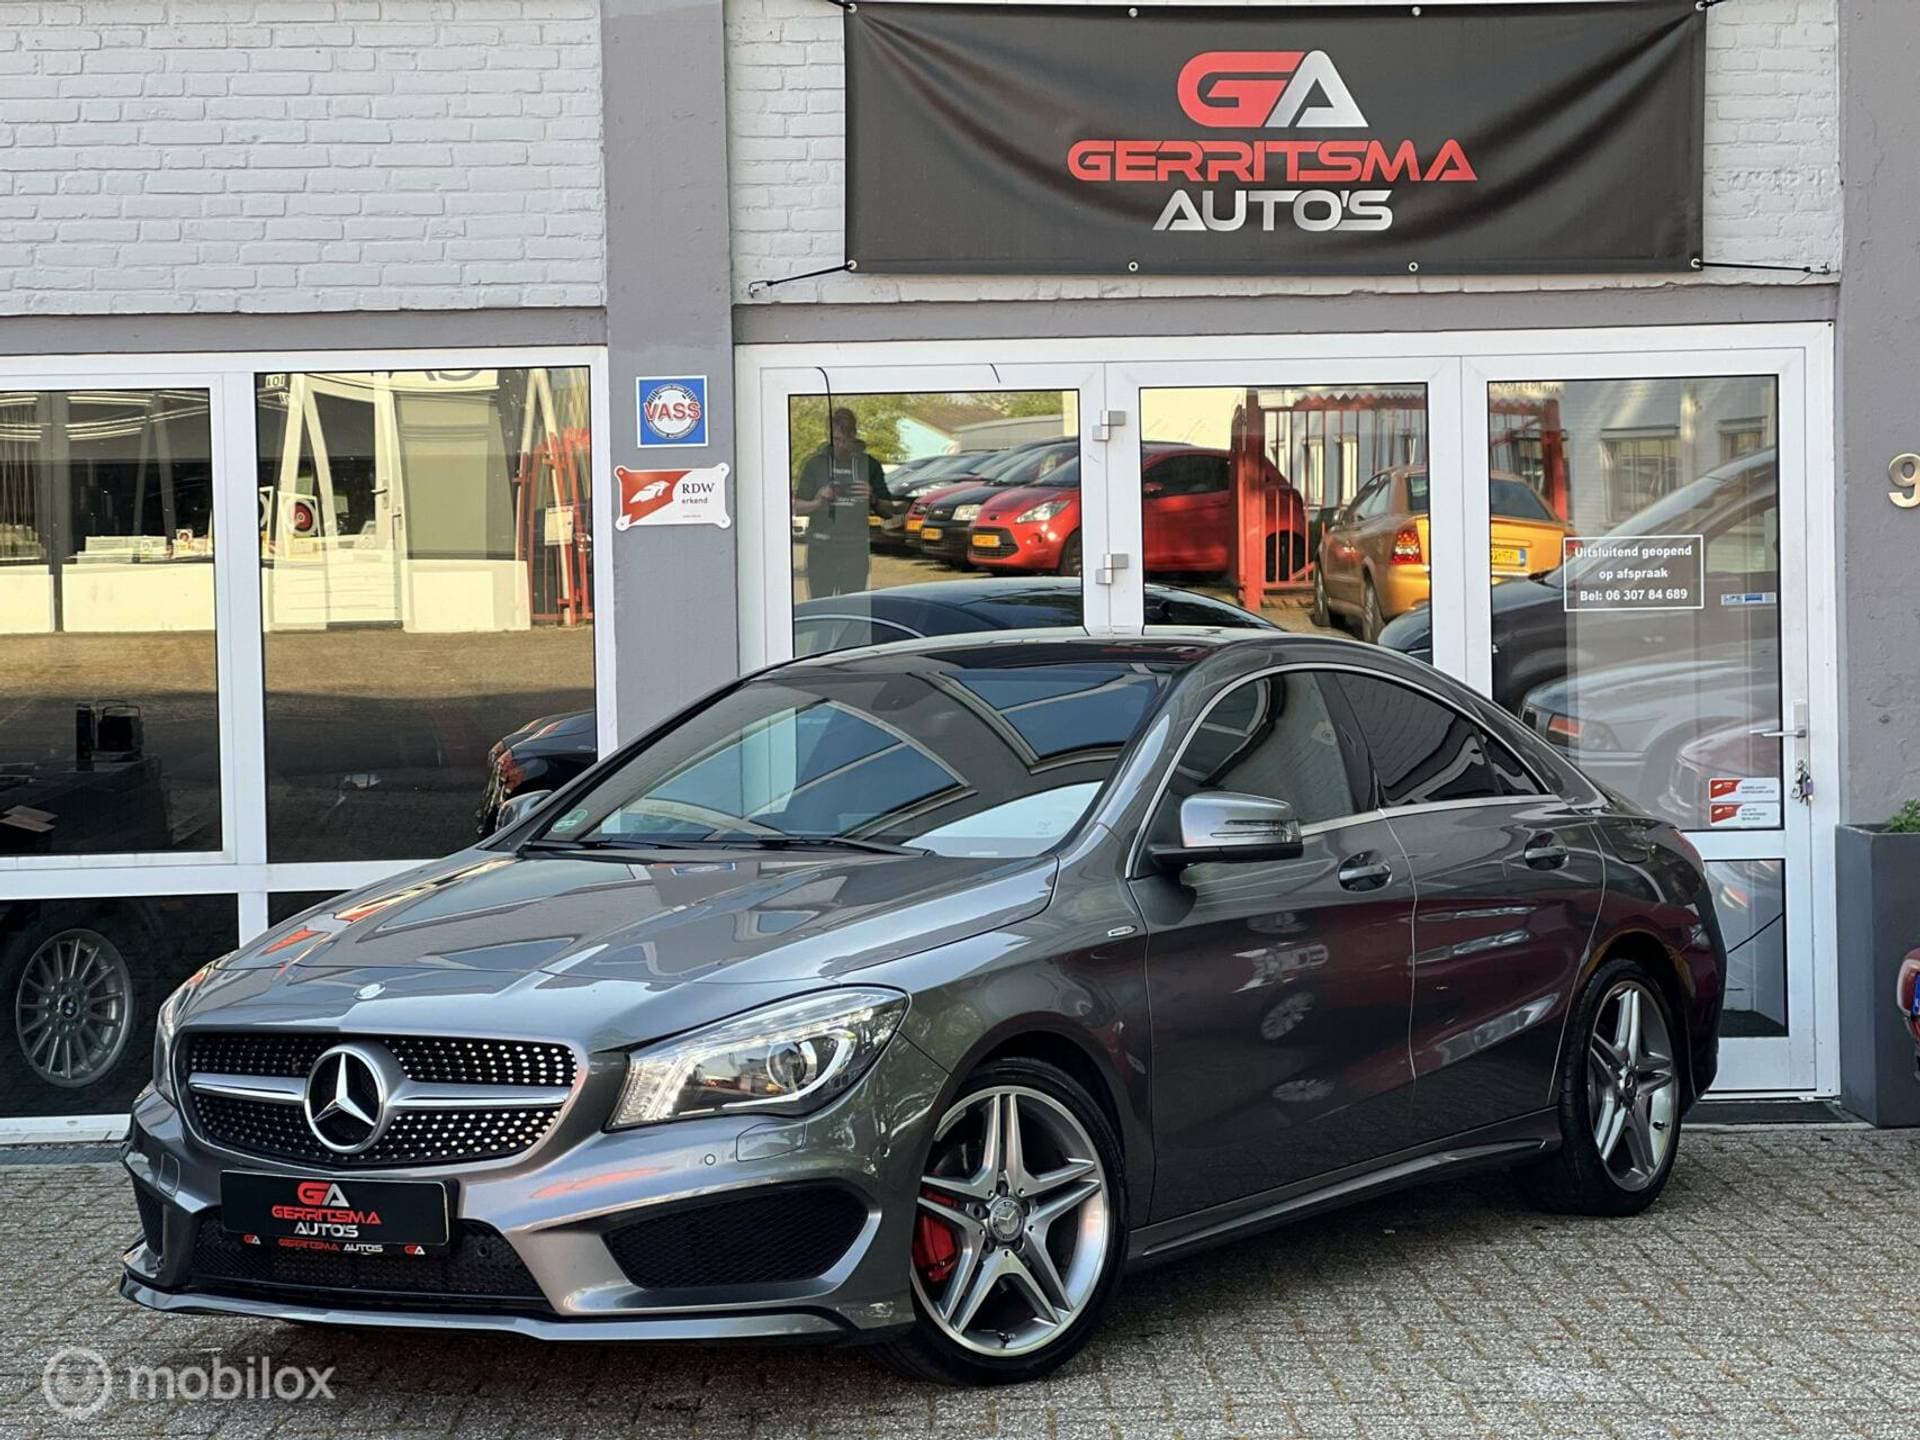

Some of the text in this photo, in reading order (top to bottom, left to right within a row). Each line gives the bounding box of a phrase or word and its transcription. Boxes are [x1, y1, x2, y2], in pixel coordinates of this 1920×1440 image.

[1176, 49, 1369, 129] GA
[1066, 139, 1478, 183] GERRITSMA
[1152, 189, 1393, 232] AUTO'S
[644, 402, 701, 421] VASS
[682, 482, 715, 493] RDW
[1888, 452, 1920, 509] 9
[681, 495, 709, 505] erkend
[1575, 545, 1692, 559] Uitsluitend geopend
[1599, 567, 1669, 581] op afspraak
[1580, 588, 1689, 601] Bel: 06 307 84 689
[297, 1181, 350, 1207] GA
[271, 1205, 382, 1225] GERRITSMA
